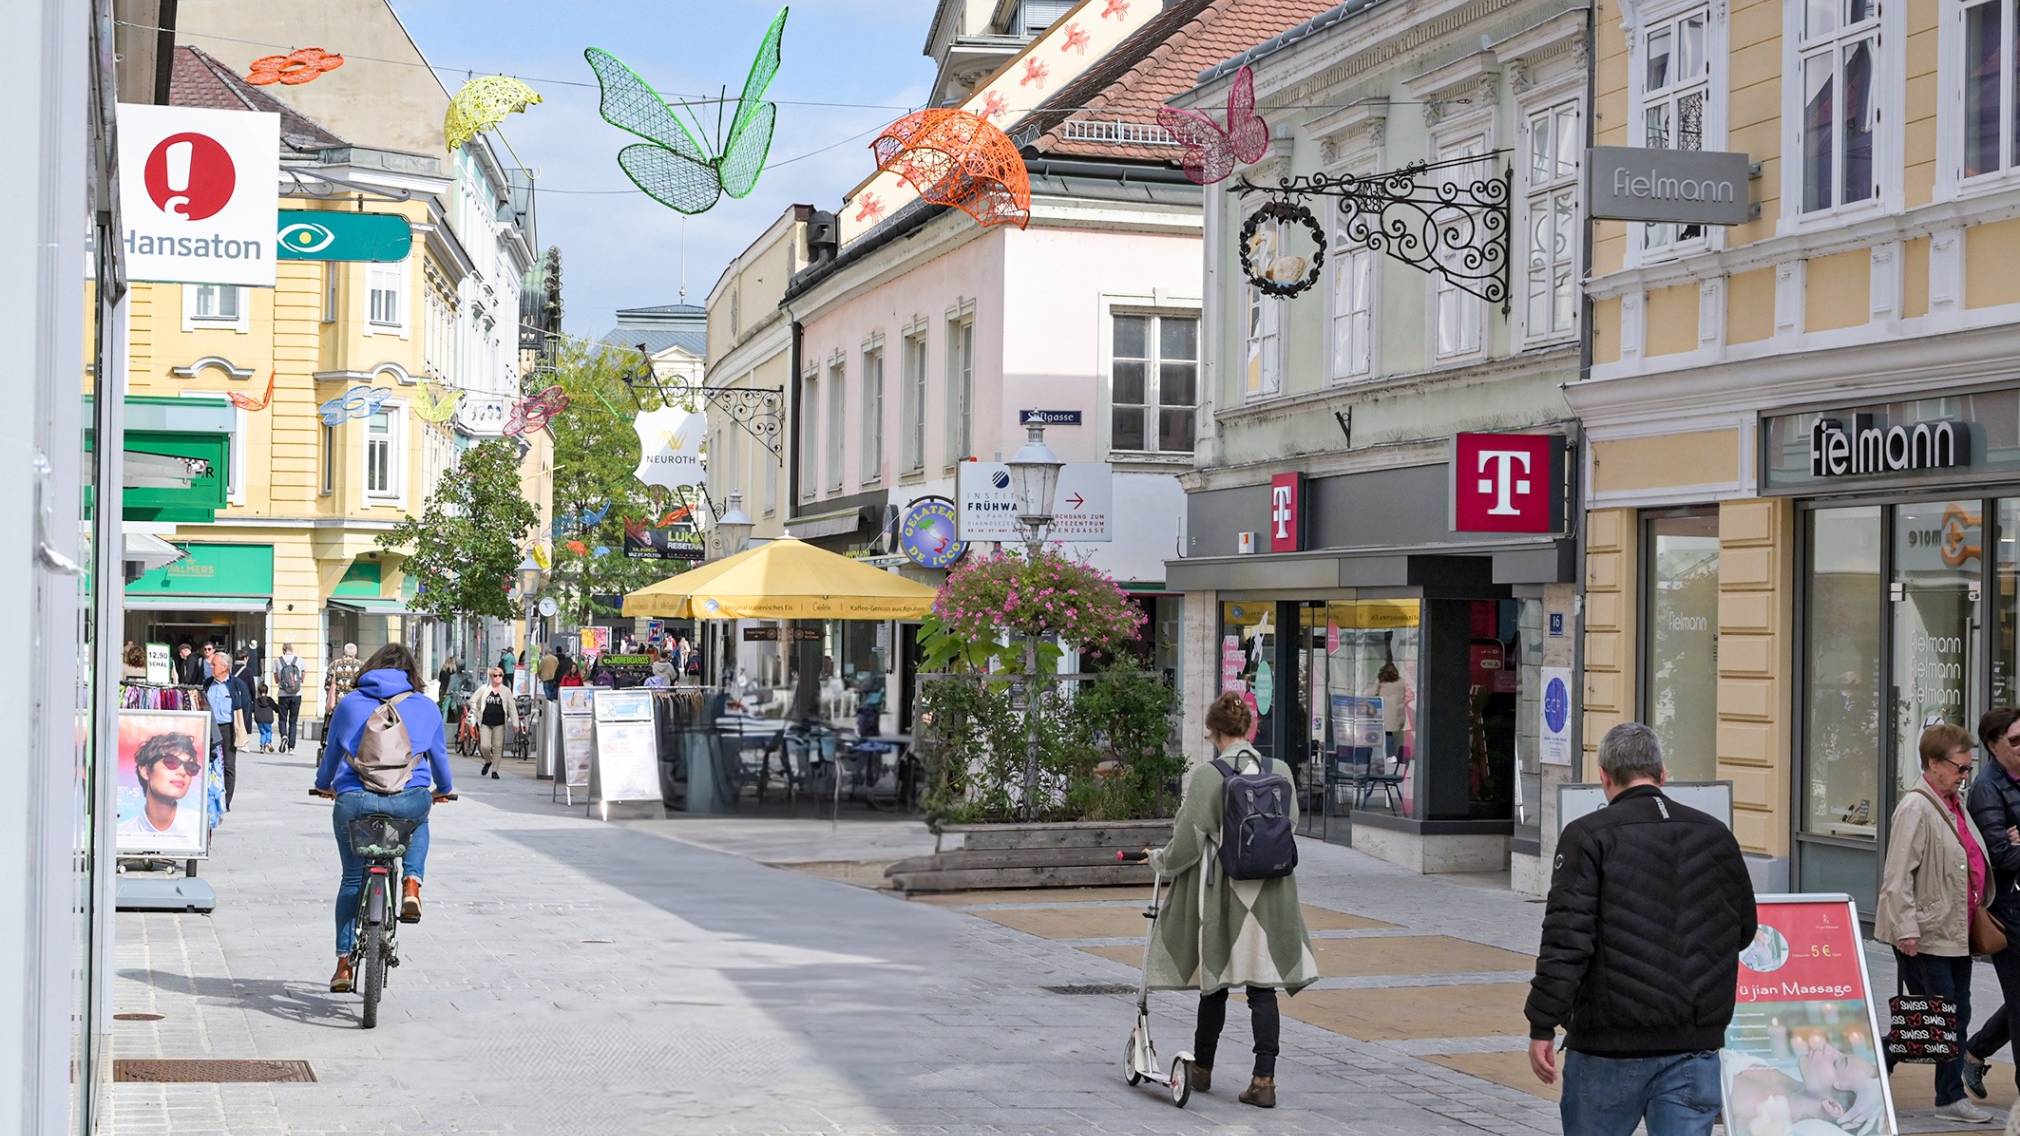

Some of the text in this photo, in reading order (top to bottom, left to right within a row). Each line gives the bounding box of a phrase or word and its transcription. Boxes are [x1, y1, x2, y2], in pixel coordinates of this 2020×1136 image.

[646, 455, 696, 464] NEUROTH
[1811, 945, 1820, 957] 5
[1782, 981, 1852, 997] Massage
[1900, 1000, 1929, 1011] SWISS
[1900, 1029, 1930, 1040] SWISS
